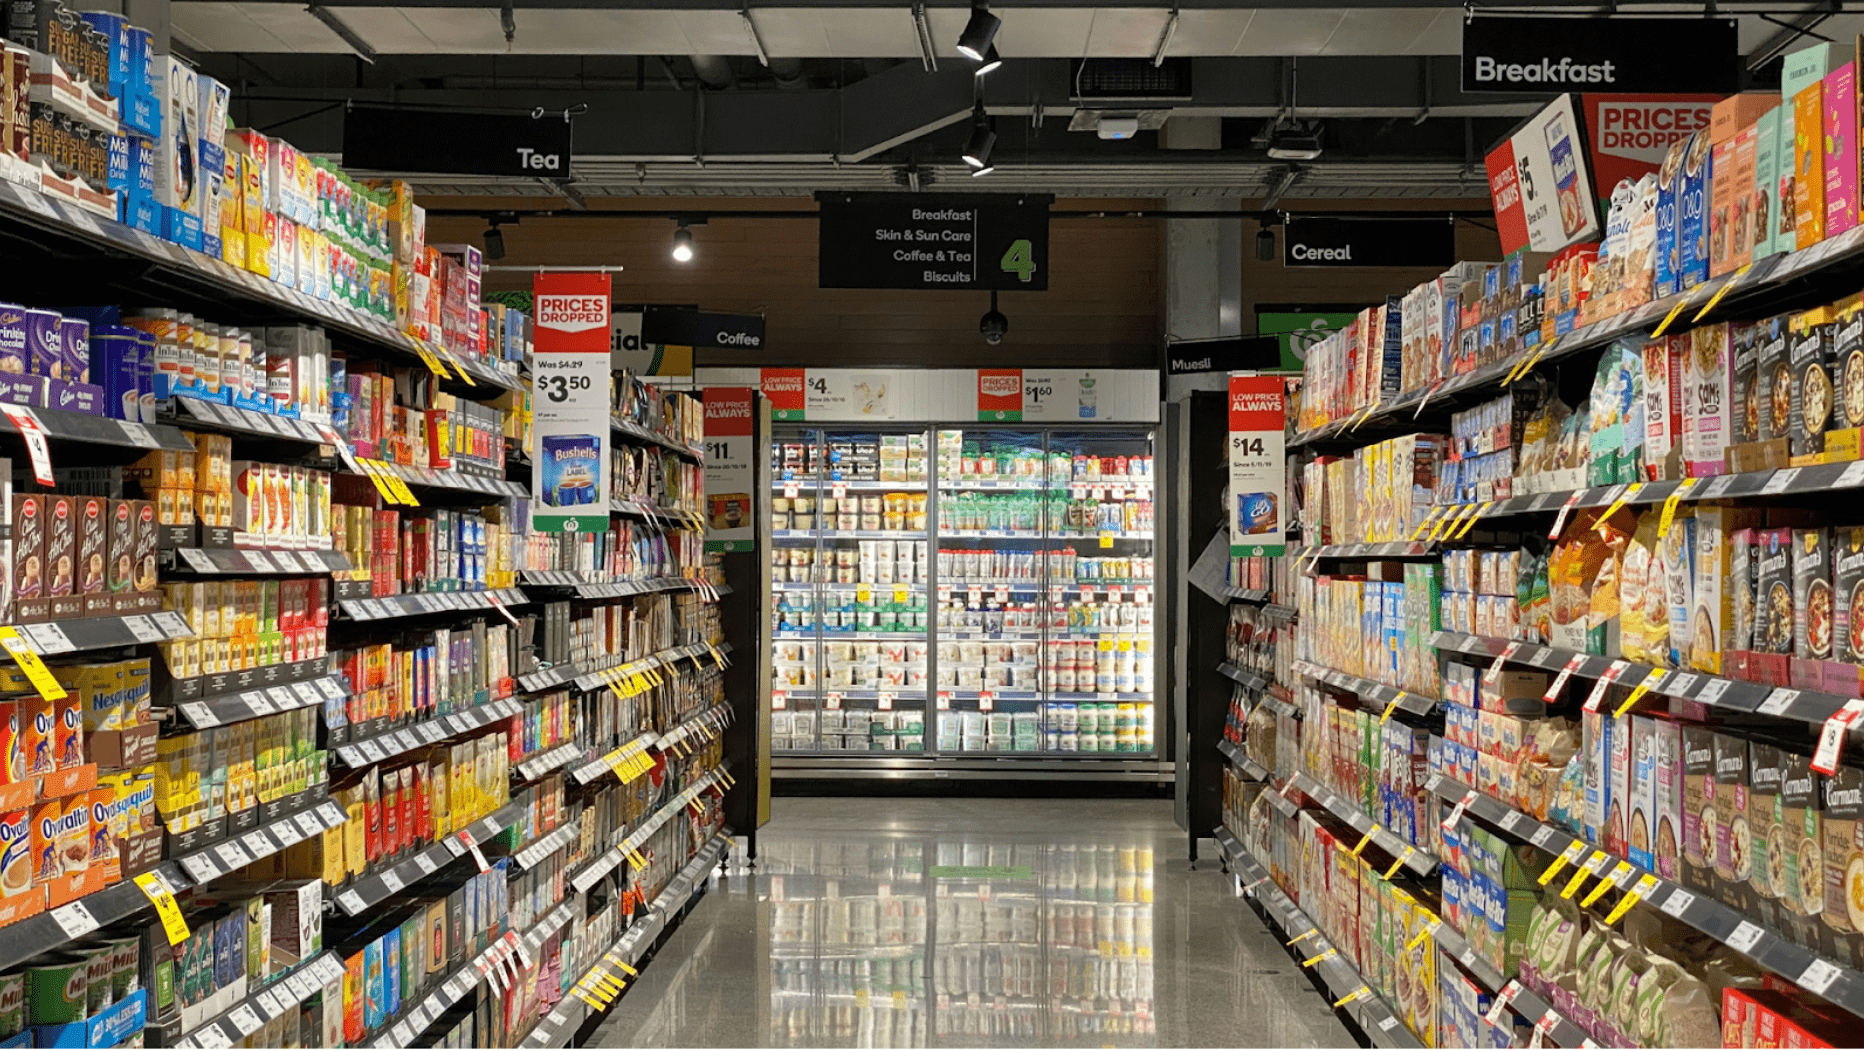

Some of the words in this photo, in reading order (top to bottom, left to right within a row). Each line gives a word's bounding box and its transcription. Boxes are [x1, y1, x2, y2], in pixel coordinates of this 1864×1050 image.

[1475, 56, 1616, 83] Breakfast
[1604, 108, 1711, 130] PRICES
[516, 148, 560, 170] Tea
[912, 209, 972, 221] Breakfast
[875, 229, 901, 240] Skin
[903, 229, 913, 241] &
[915, 230, 939, 241] Sun
[941, 230, 971, 242] Care
[893, 250, 934, 262] Coffee
[935, 250, 945, 262] &
[947, 250, 971, 262] Tea
[1291, 243, 1352, 261] Cereal
[1001, 239, 1036, 282] 4
[923, 271, 971, 283] Biscuits
[541, 298, 604, 312] PRICES
[540, 312, 604, 323] DROPPED
[716, 331, 761, 347] Coffee
[538, 360, 557, 369] Was
[1172, 357, 1211, 371] Muesli
[808, 377, 828, 394] $4
[1232, 393, 1254, 402] LOW
[1254, 393, 1281, 402] PRICE
[705, 401, 725, 409] LOW
[725, 401, 750, 409] PRICE
[1232, 401, 1283, 412] ALWAYS
[705, 408, 751, 419] ALWAYS
[555, 445, 598, 462] Bushells
[706, 441, 728, 460] $11
[1233, 438, 1265, 457] $14
